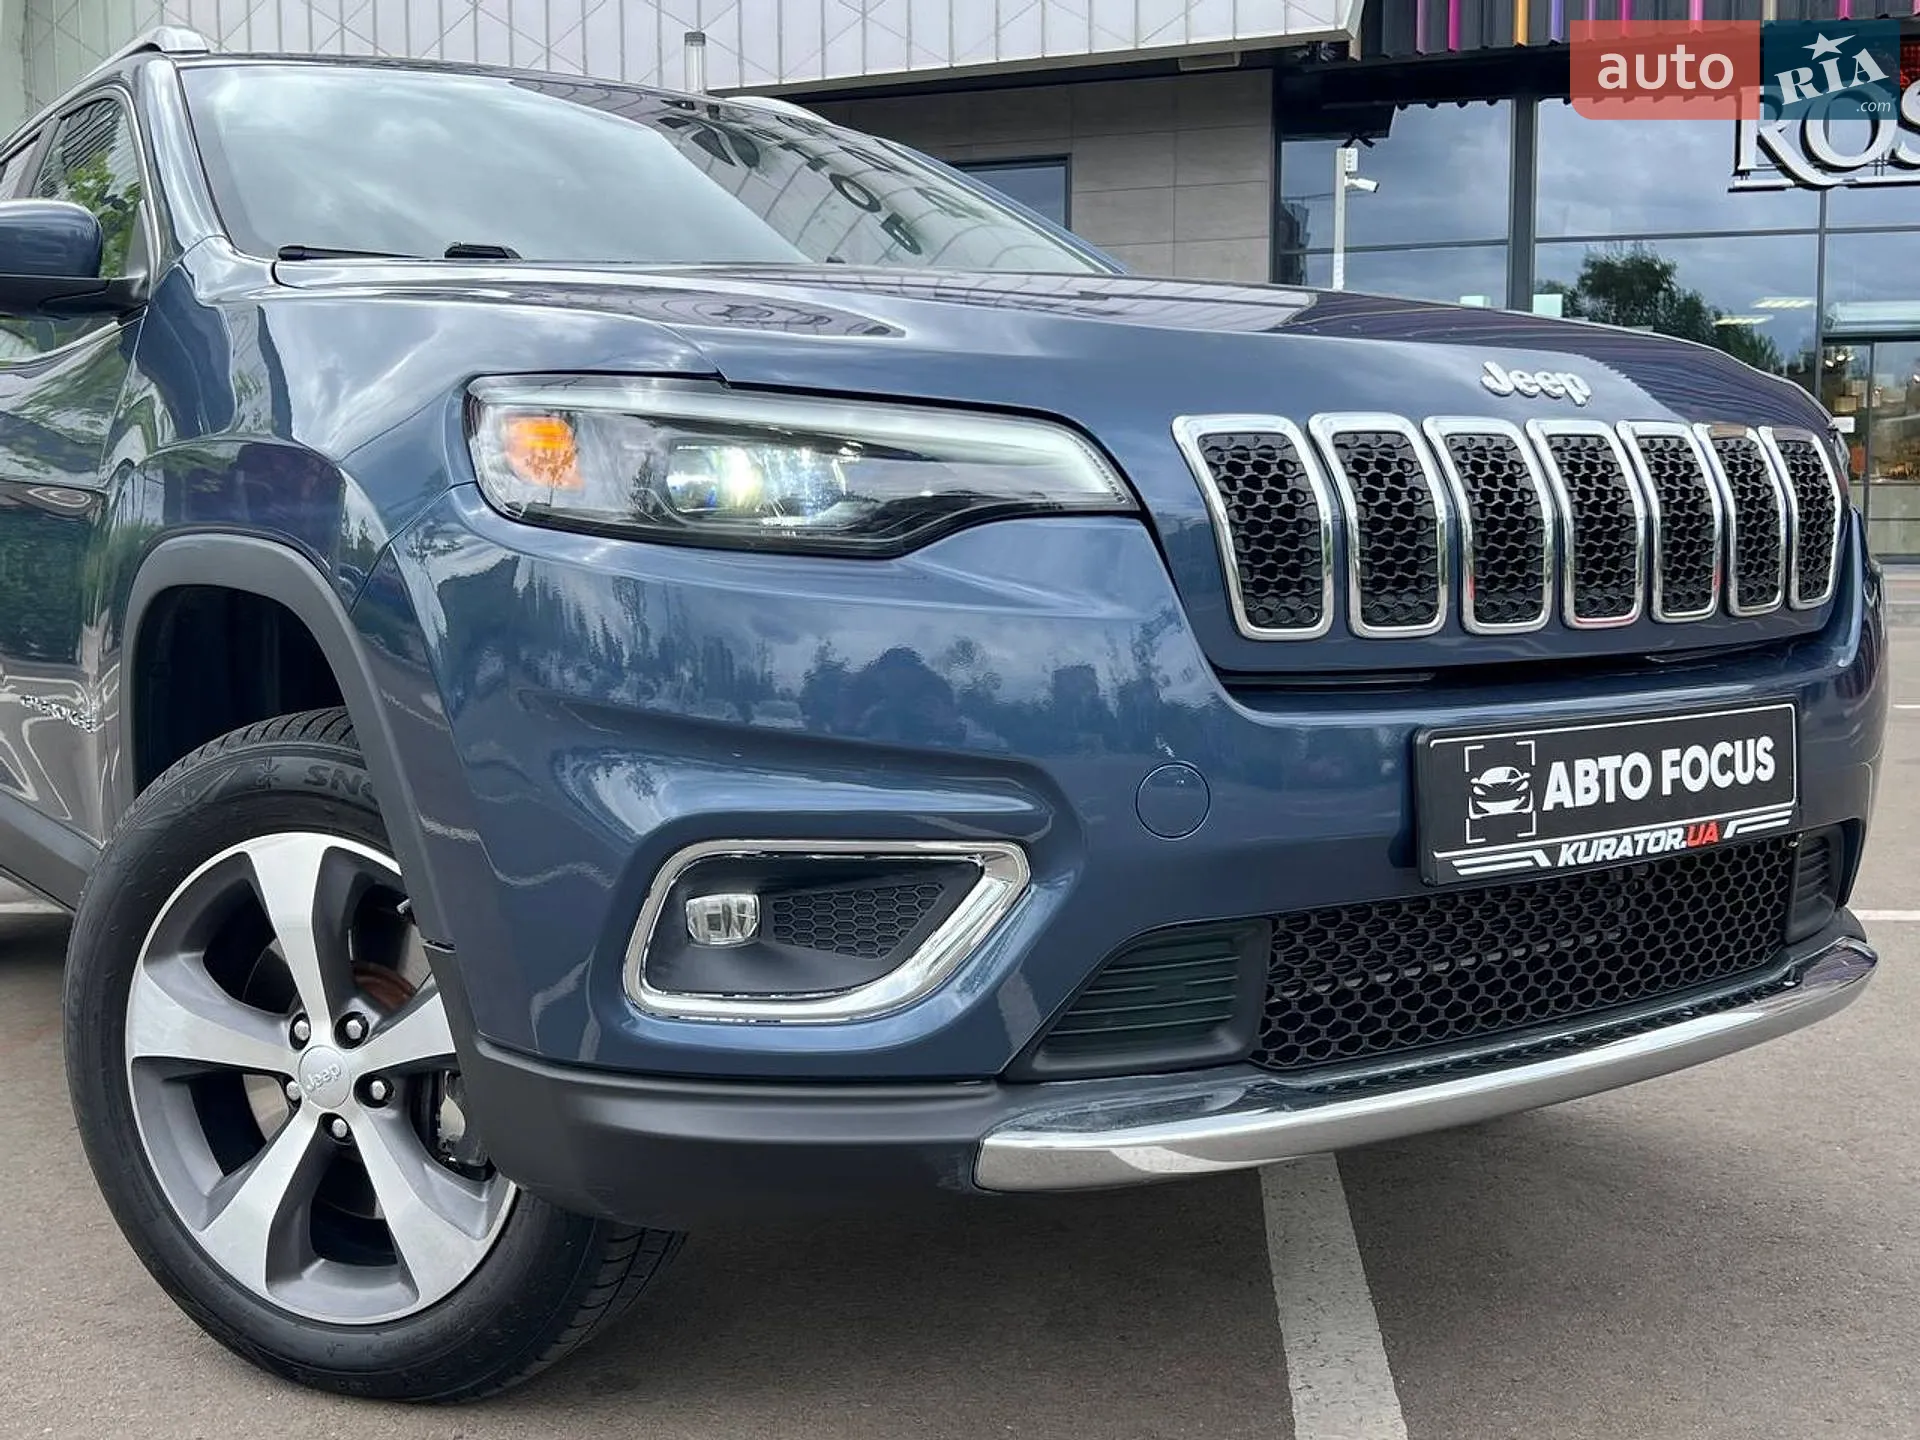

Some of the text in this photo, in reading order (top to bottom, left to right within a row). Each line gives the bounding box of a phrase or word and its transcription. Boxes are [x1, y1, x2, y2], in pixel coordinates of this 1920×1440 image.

[1480, 361, 1591, 406] Jeep
[1661, 735, 1776, 796] FOCUS
[1556, 821, 1721, 868] KURATOR.UA
[306, 1064, 341, 1091] Jeep
